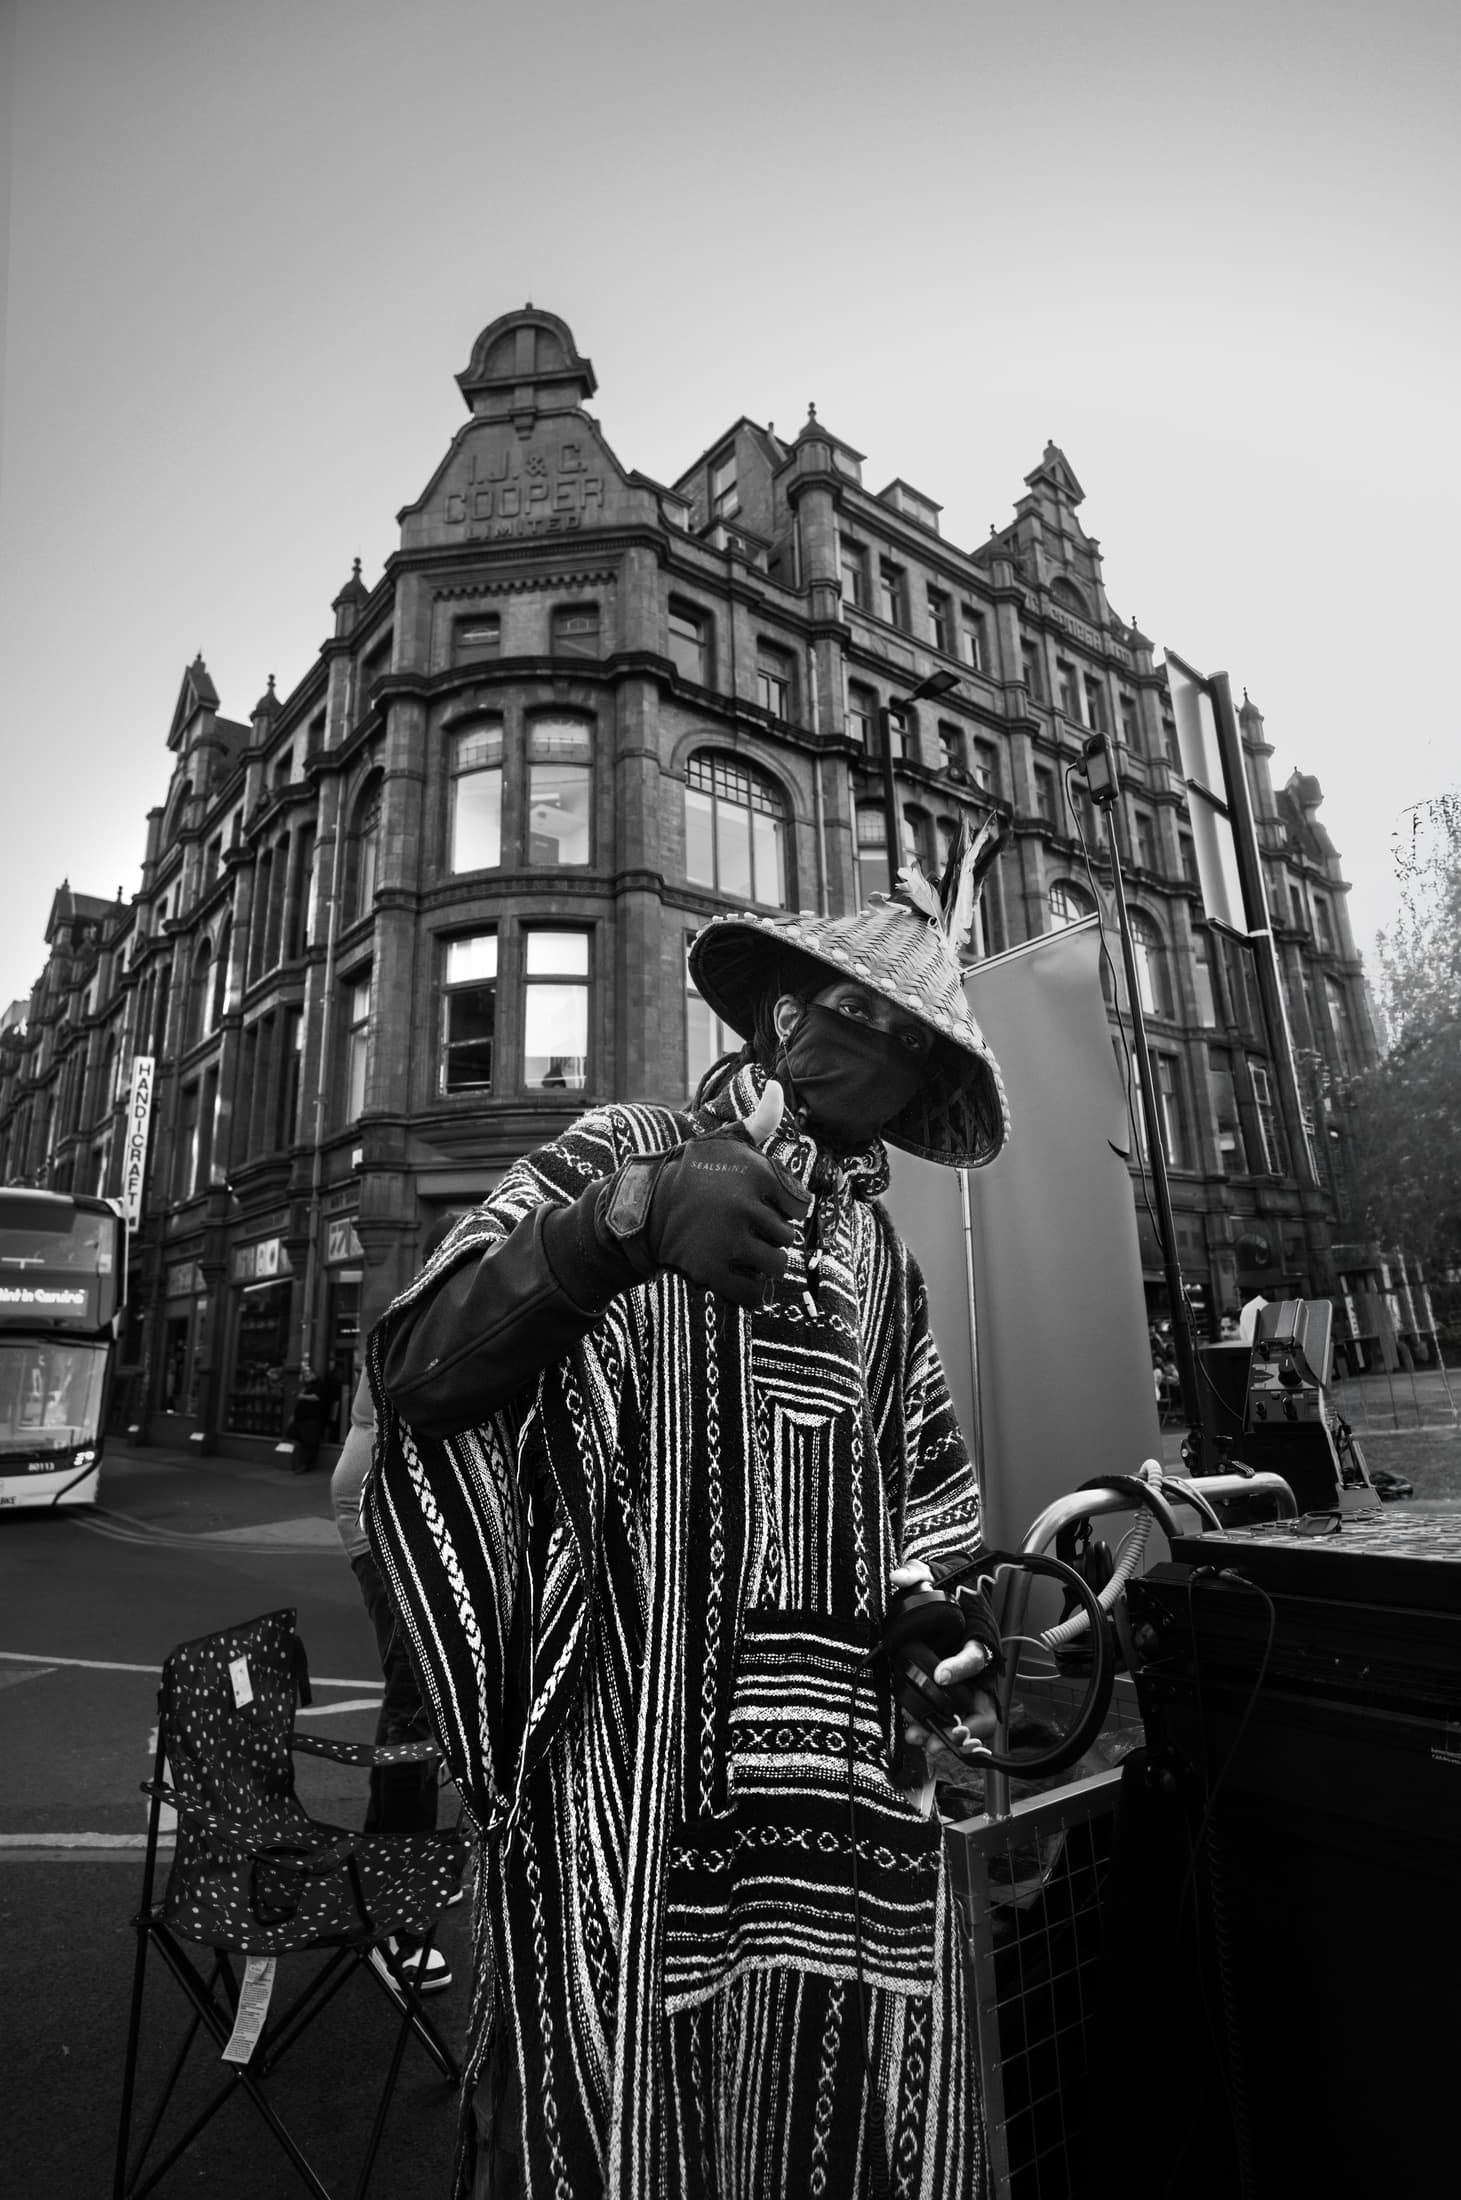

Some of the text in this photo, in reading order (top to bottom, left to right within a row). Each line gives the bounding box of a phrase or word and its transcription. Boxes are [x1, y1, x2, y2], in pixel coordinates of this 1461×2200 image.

[525, 457, 549, 478] &
[443, 478, 605, 525] COOPER
[467, 517, 581, 542] LIMITED
[128, 1063, 151, 1207] HANDICRAFT
